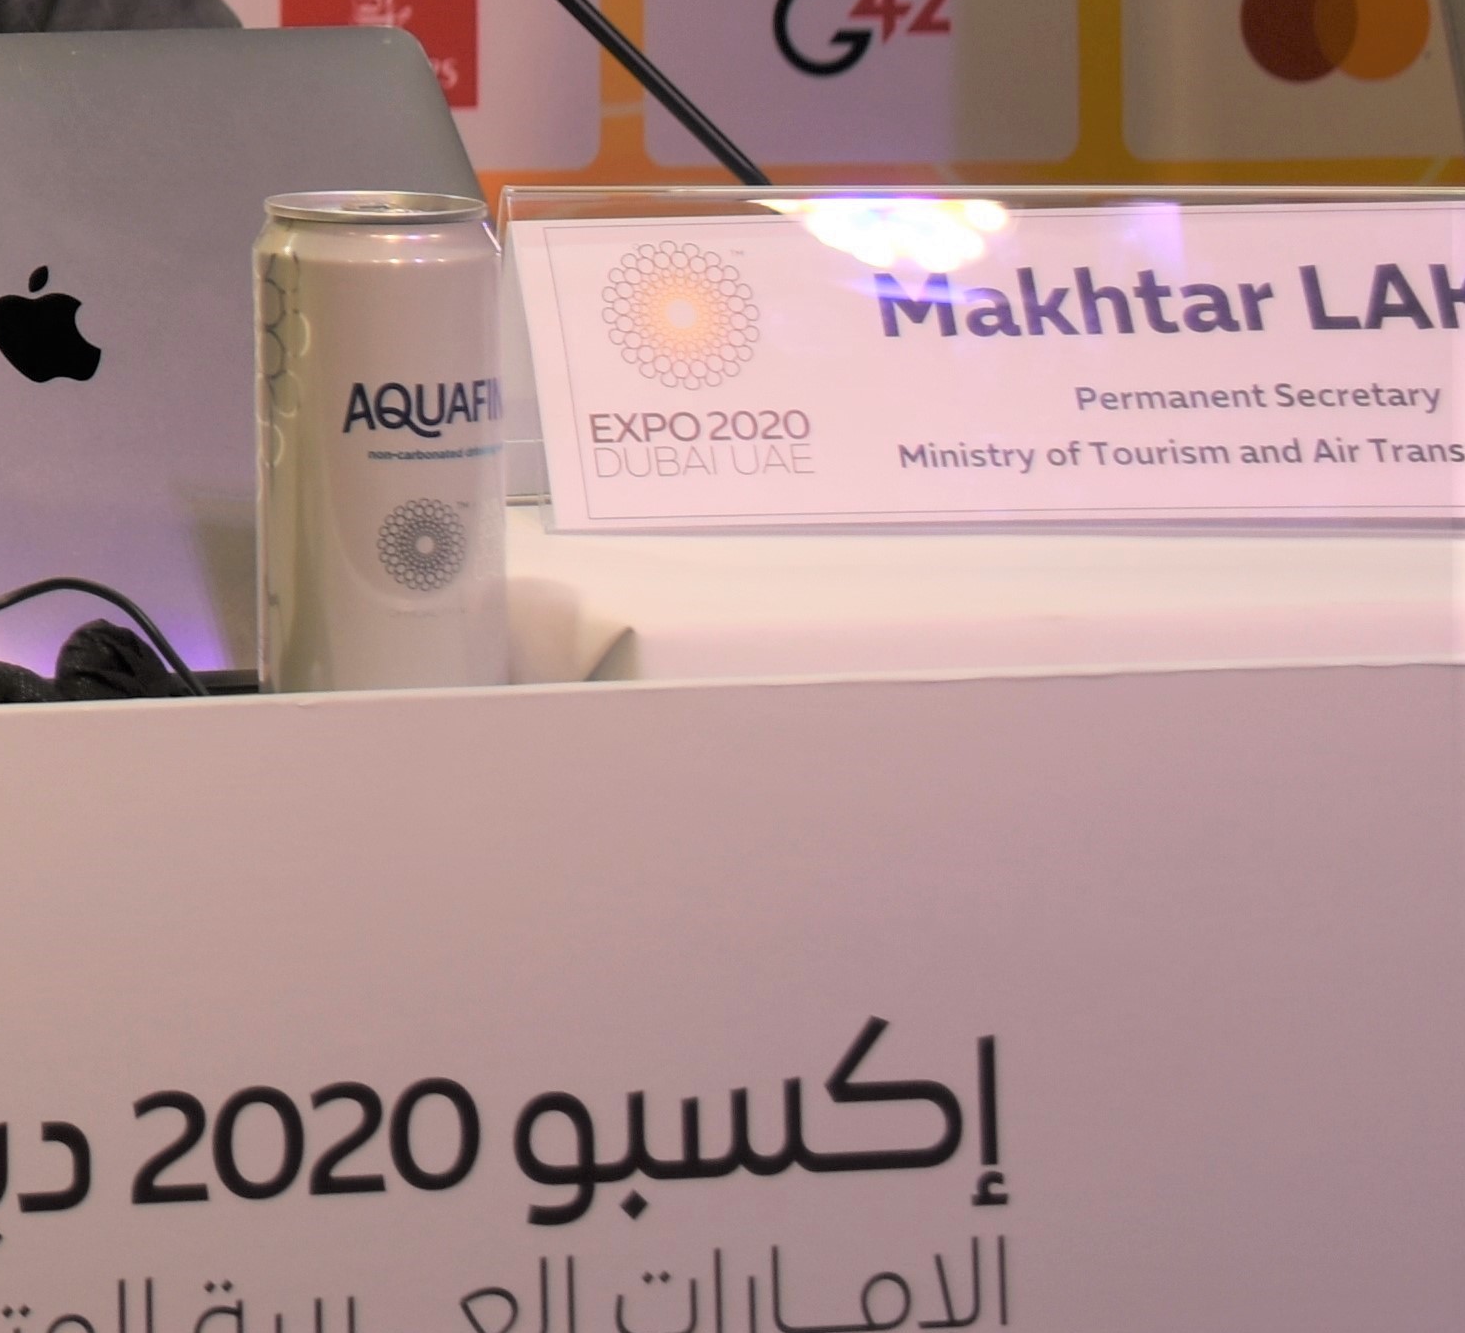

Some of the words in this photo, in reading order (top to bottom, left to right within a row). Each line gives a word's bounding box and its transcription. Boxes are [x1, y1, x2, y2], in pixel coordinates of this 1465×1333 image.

[874, 264, 1273, 338] Makhtar
[1076, 384, 1267, 410] Permanent
[1275, 383, 1440, 413] Secretary
[590, 412, 701, 443] EXPO
[708, 410, 810, 441] 2020
[593, 446, 717, 478] DUBAI
[731, 443, 815, 476] UAE
[899, 443, 1034, 474] Ministry
[1047, 441, 1080, 466] of
[1089, 439, 1230, 465] Tourism
[1240, 438, 1302, 463] and
[1314, 438, 1359, 462] Air
[514, 1017, 1008, 1226] إكسبو
[132, 1078, 480, 1204] 2020
